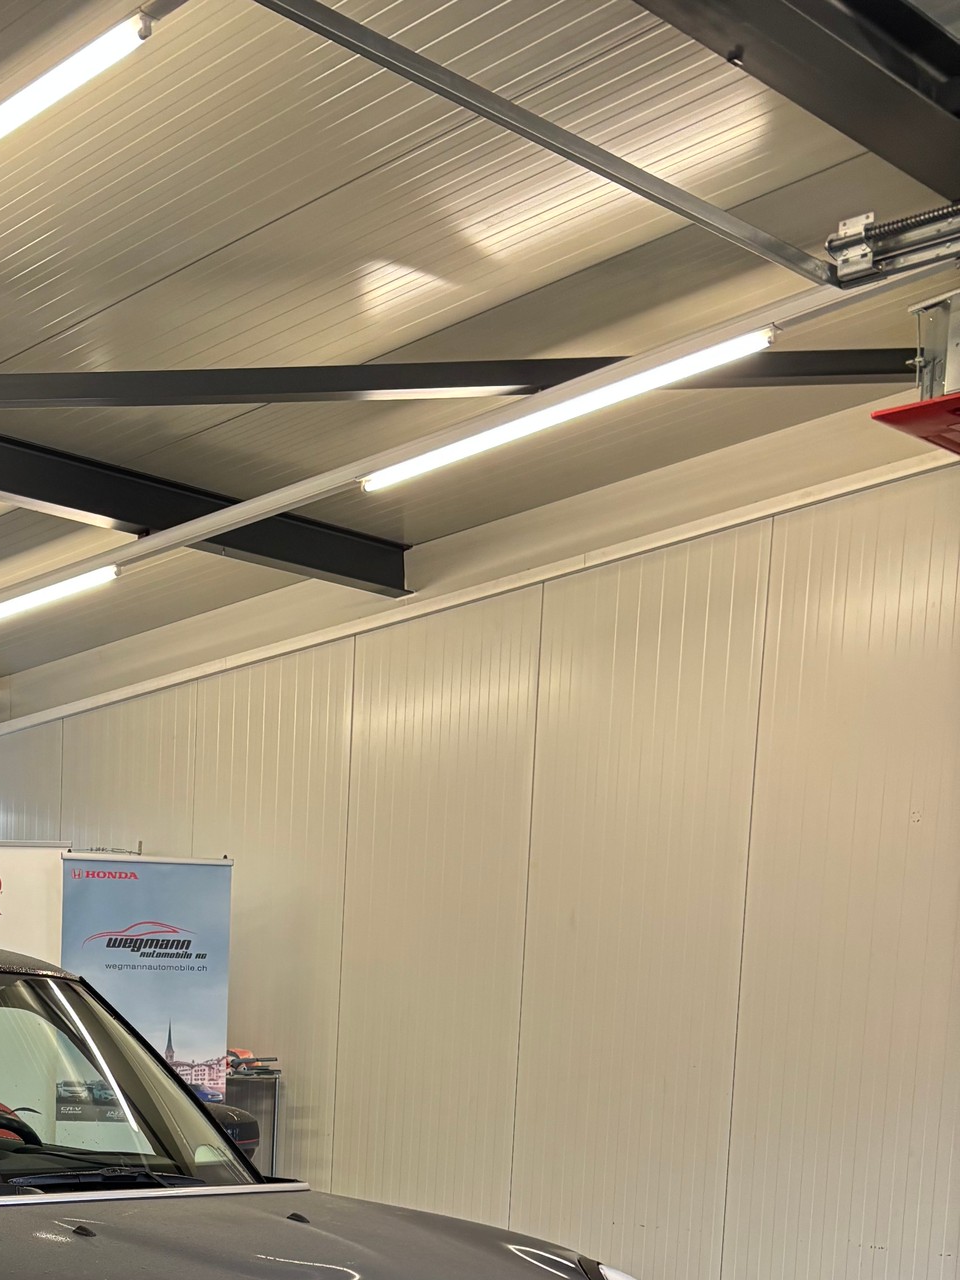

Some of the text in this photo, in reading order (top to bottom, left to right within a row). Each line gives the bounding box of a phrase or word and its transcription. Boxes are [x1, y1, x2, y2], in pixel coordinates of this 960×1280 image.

[85, 870, 139, 880] HONDA
[105, 937, 192, 953] wegmann
[104, 962, 208, 973] wegmannautomobile.ch
